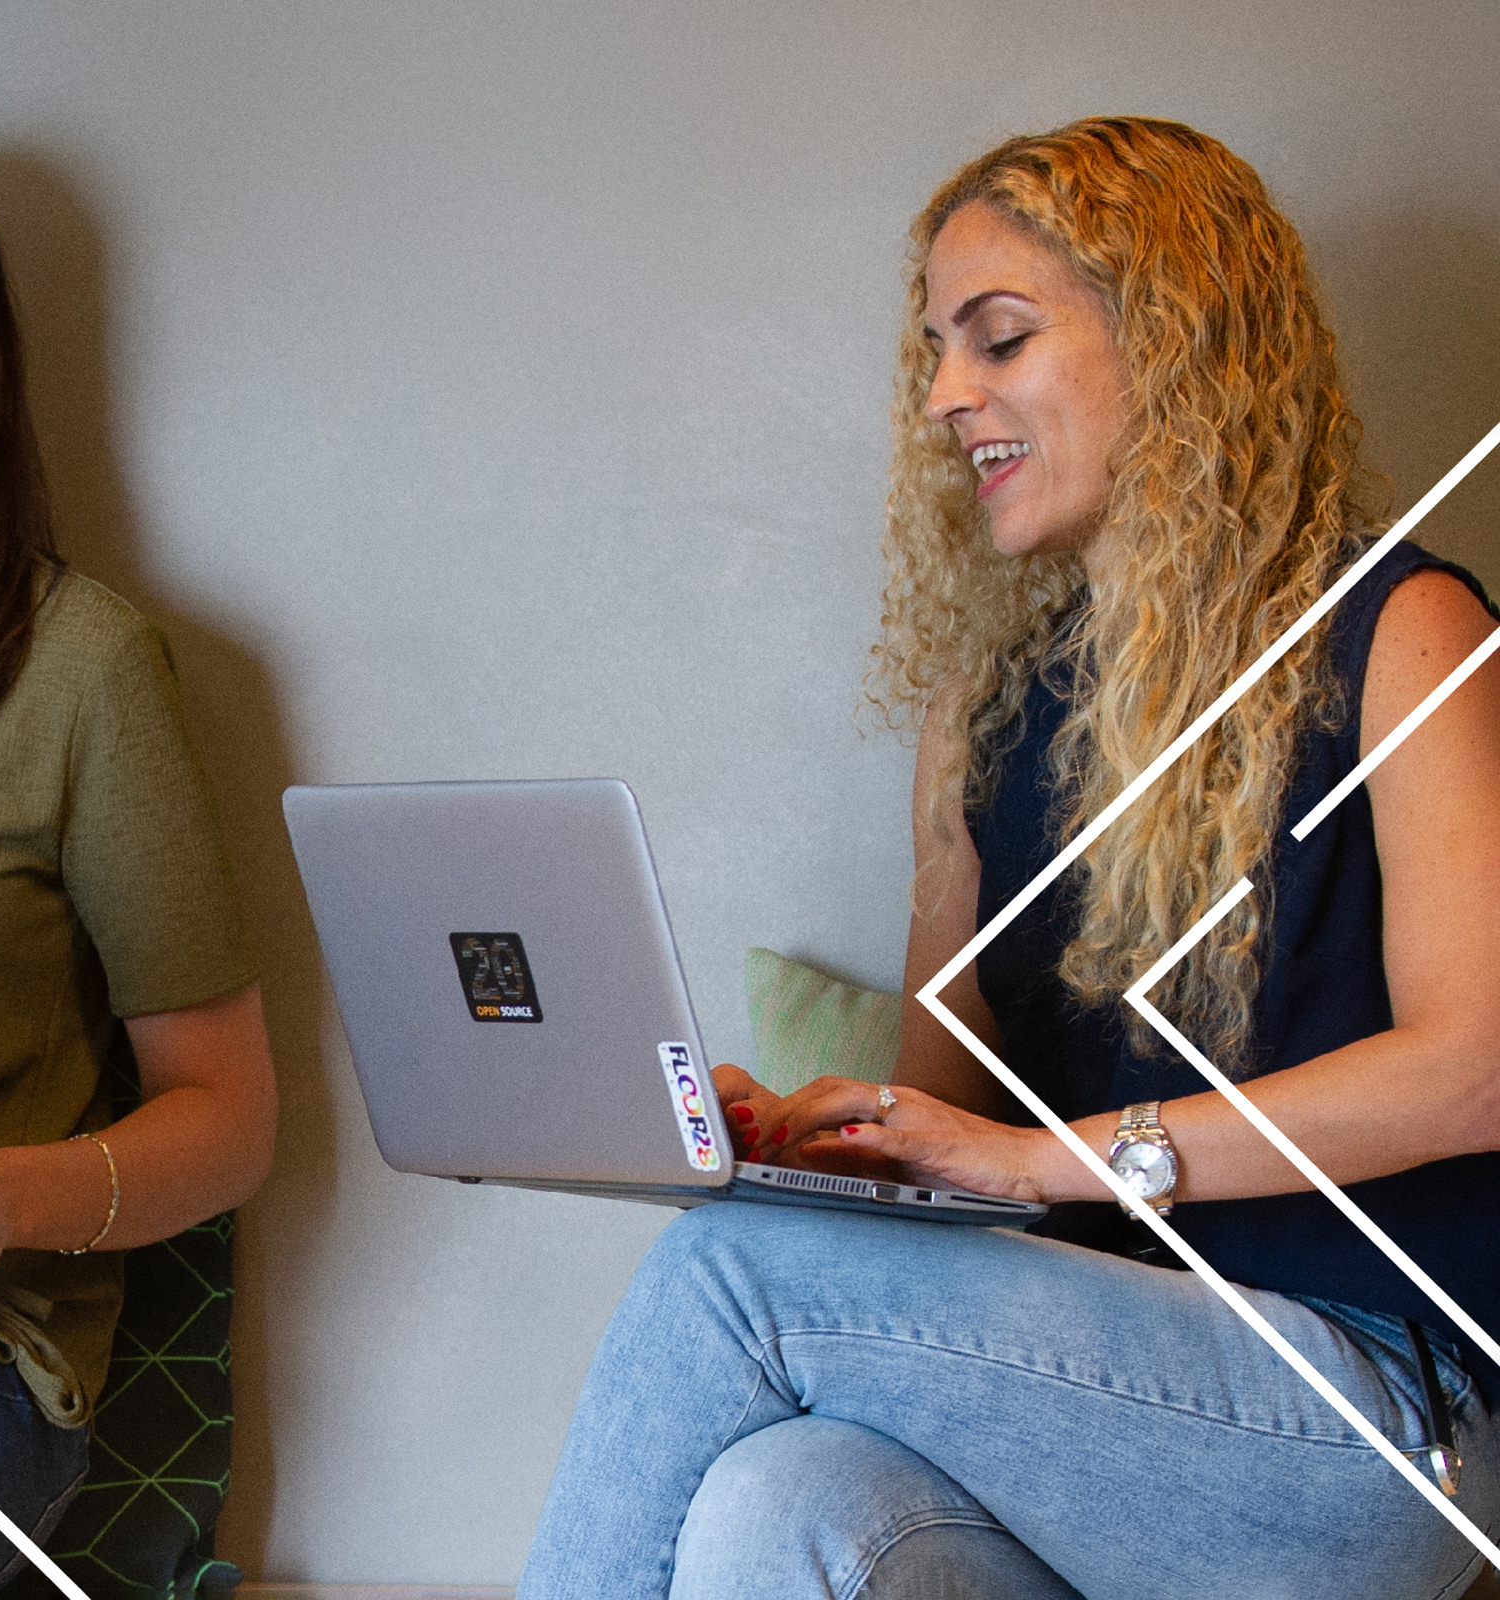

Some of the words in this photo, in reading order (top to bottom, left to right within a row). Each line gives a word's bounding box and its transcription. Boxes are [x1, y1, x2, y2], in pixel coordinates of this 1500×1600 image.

[476, 1006, 500, 1016] OPEN
[500, 1006, 533, 1017] SOURCE
[668, 1046, 718, 1166] FLOOR28
